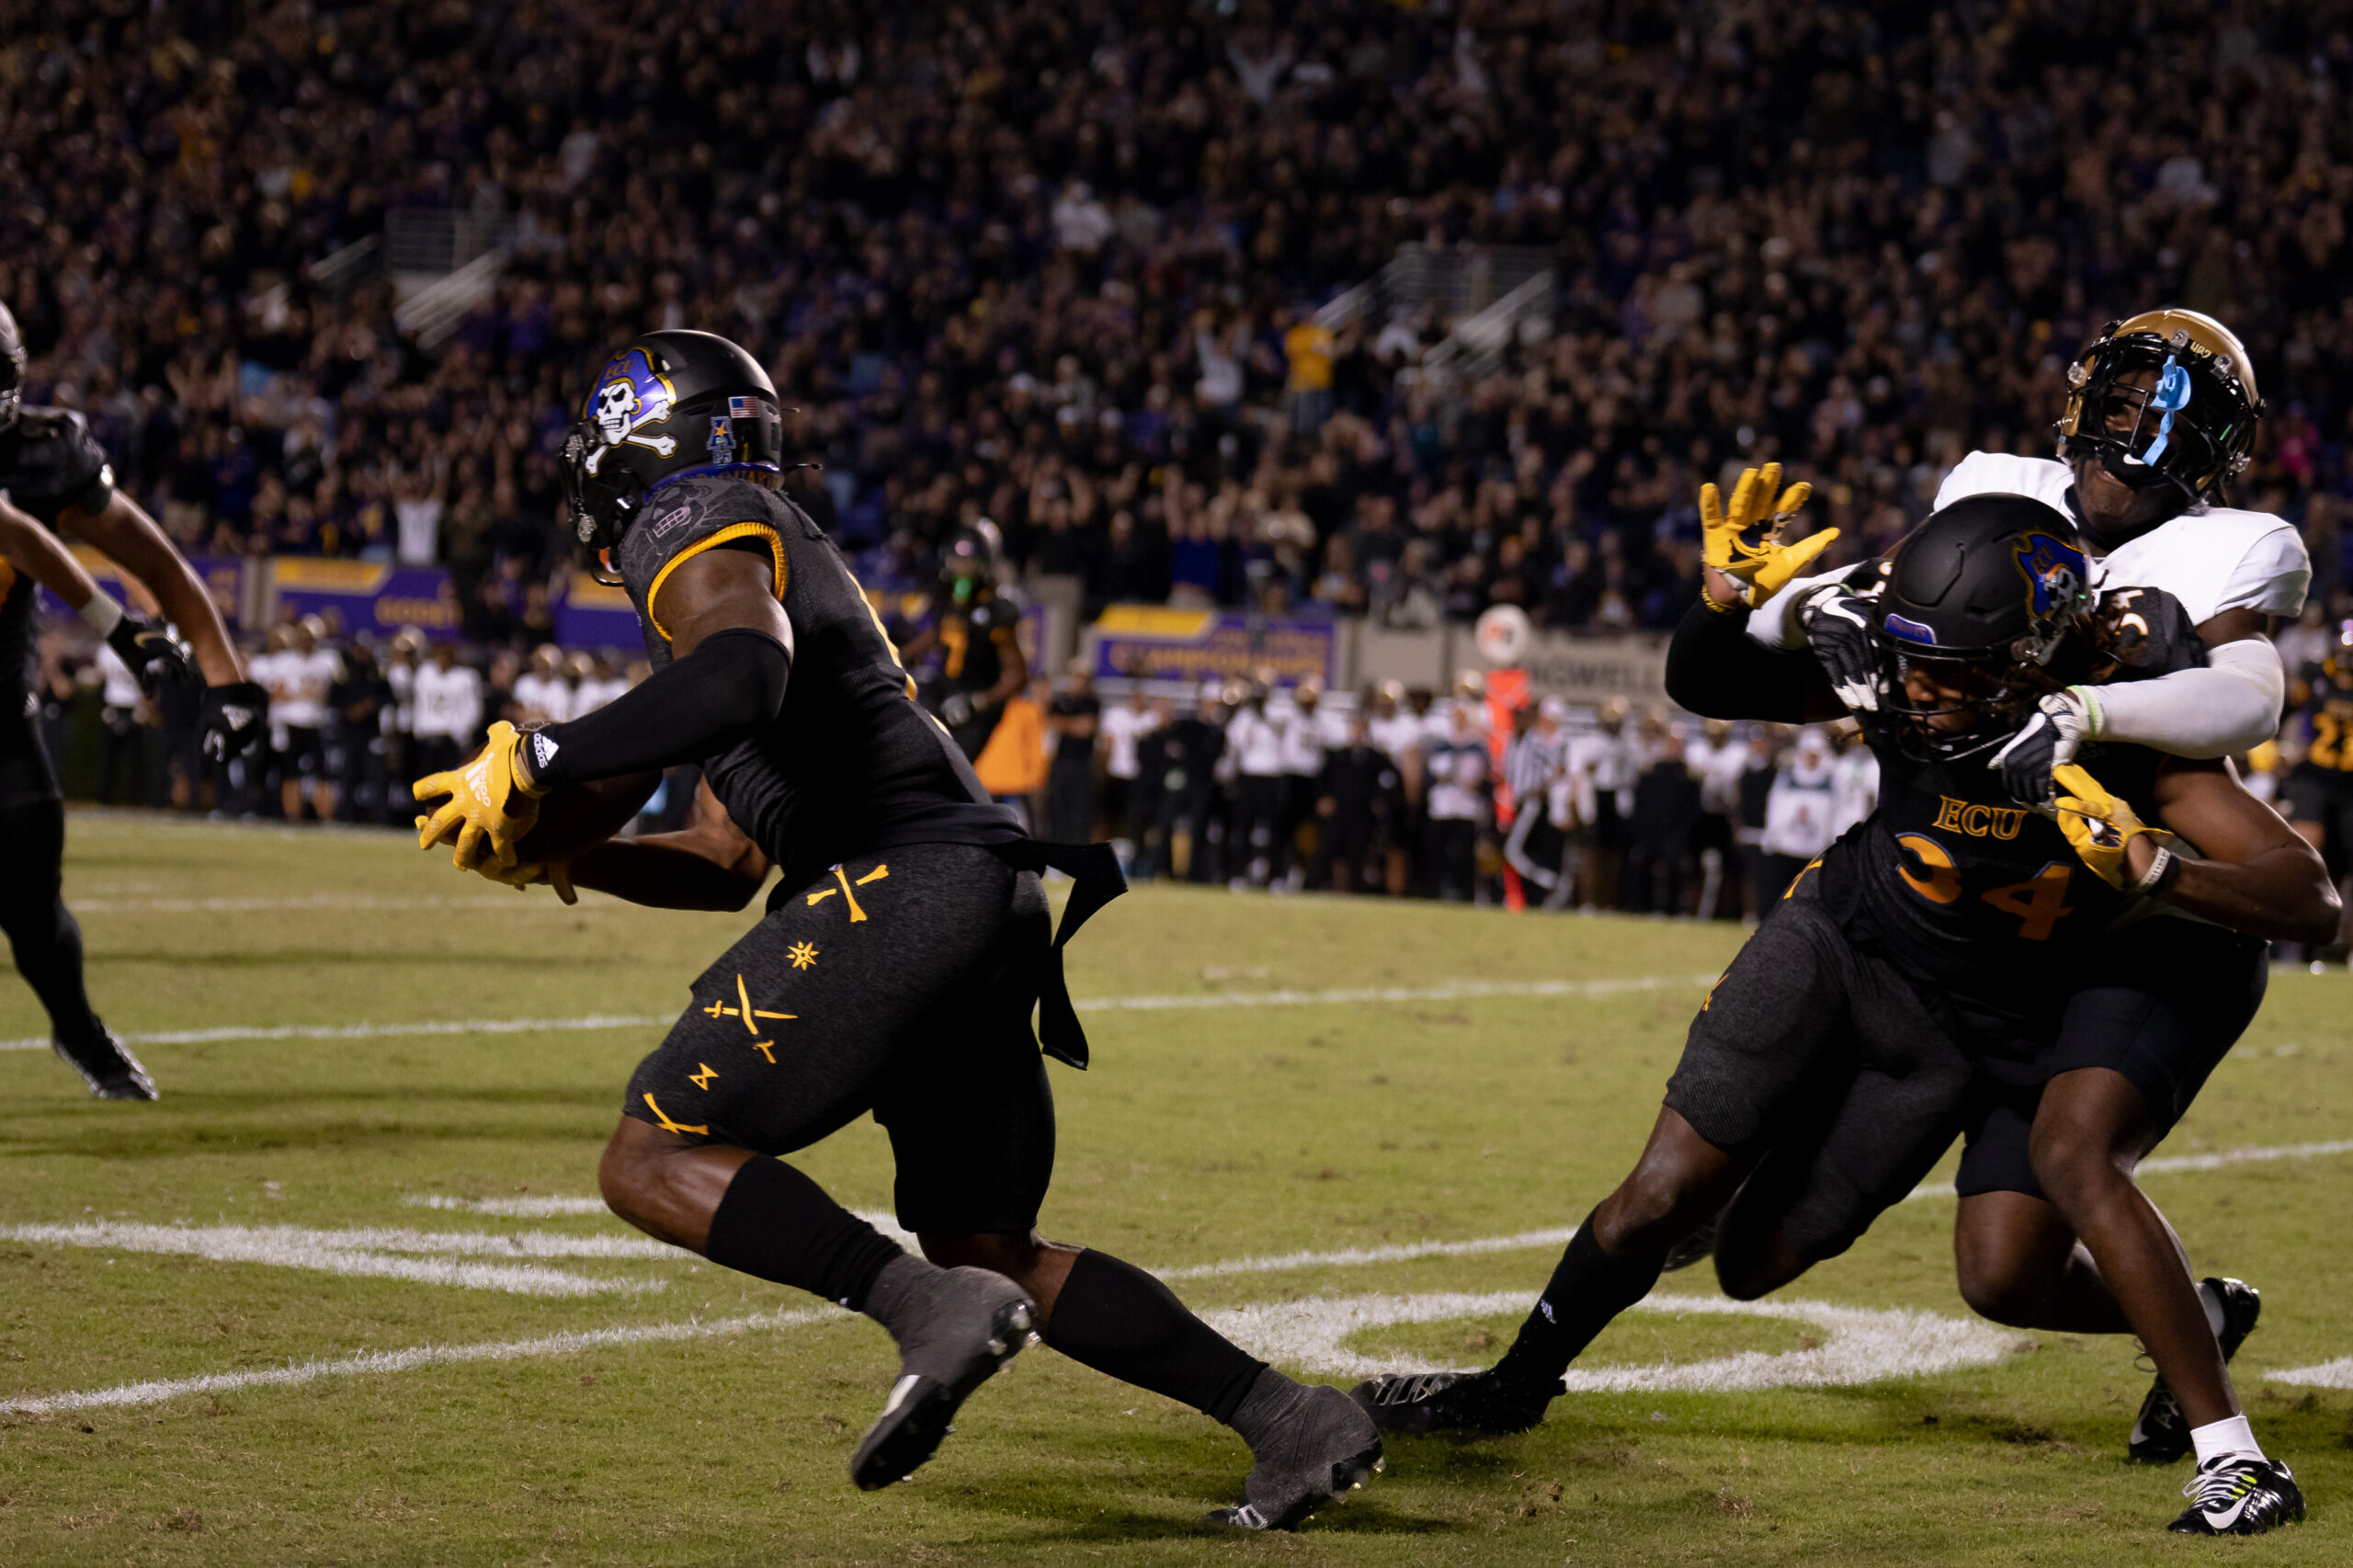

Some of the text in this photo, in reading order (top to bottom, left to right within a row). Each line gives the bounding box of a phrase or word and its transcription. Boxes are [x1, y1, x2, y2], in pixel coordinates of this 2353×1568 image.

[603, 358, 636, 381] ECU
[2029, 543, 2054, 575] ECU
[533, 733, 549, 769] adidas
[1932, 794, 2029, 841] ECU
